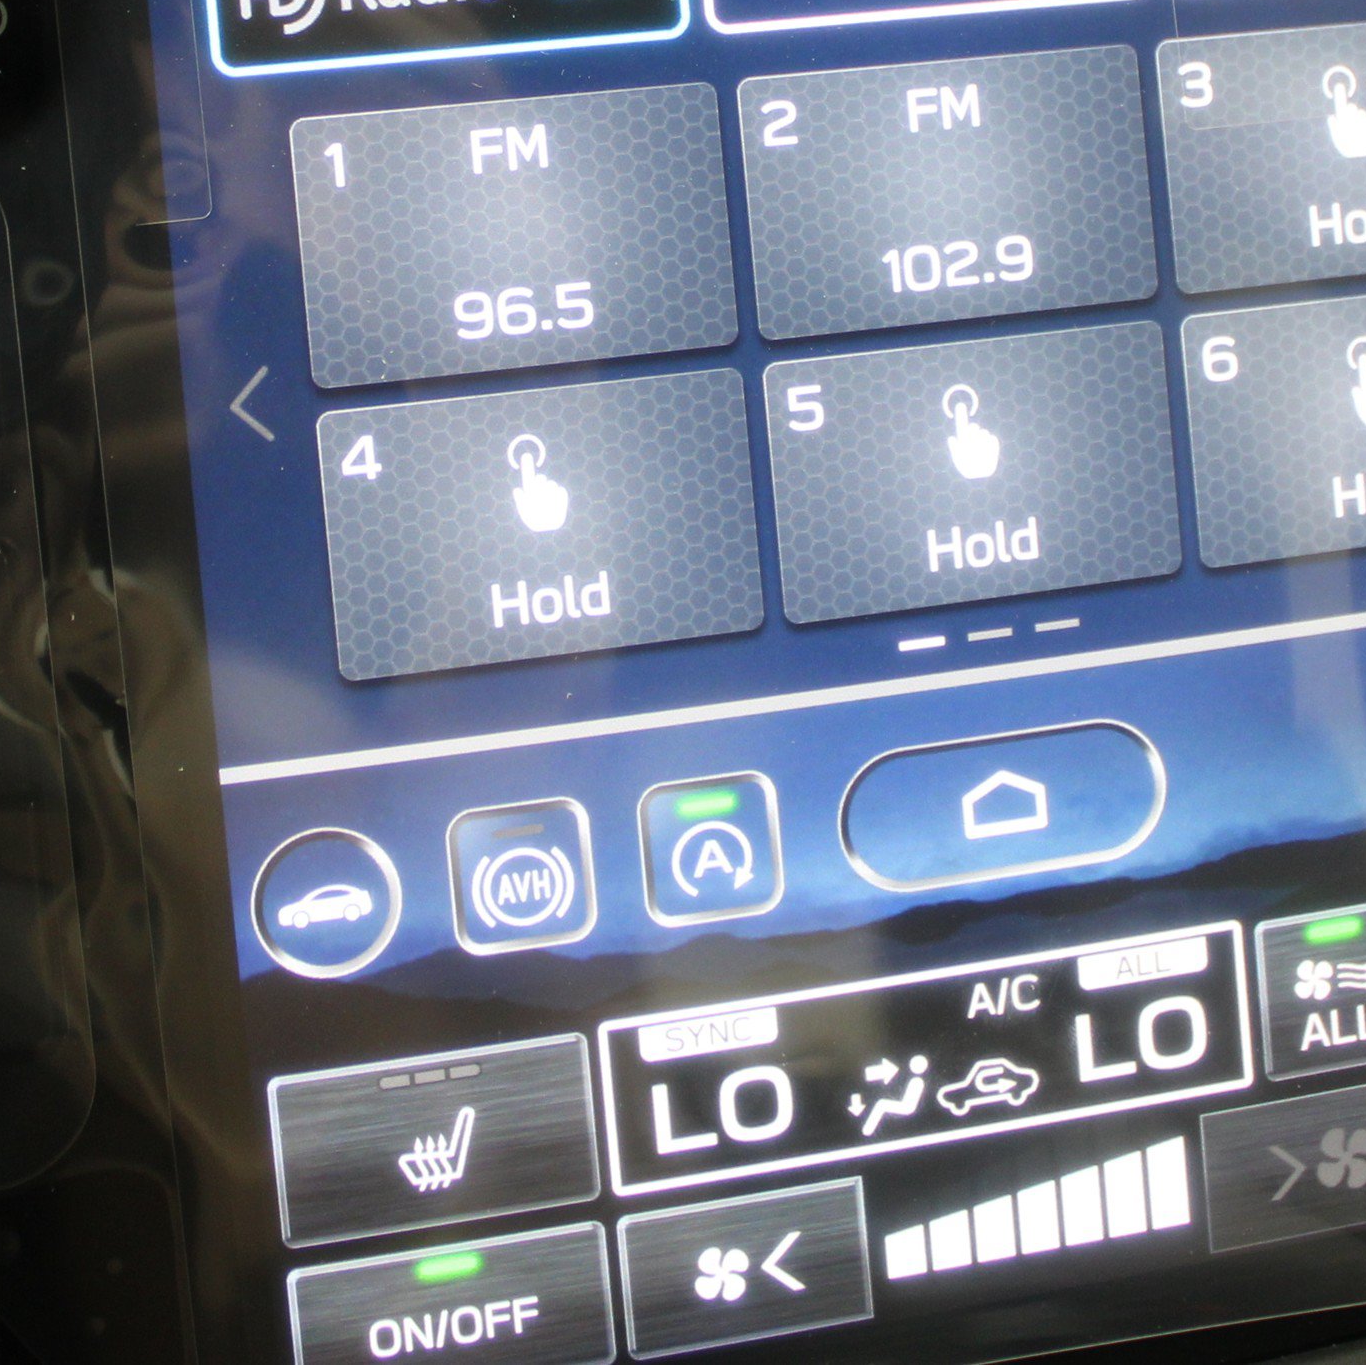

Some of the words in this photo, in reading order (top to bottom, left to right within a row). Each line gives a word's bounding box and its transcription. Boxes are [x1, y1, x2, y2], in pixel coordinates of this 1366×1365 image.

[1178, 61, 1215, 108] 3
[761, 100, 799, 147] 2
[907, 84, 981, 134] FM
[324, 142, 346, 188] 1
[470, 123, 550, 174] FM
[882, 234, 1034, 294] 102.9
[453, 281, 595, 340] 96.5
[1201, 336, 1239, 383] 6
[786, 384, 825, 432] 5
[340, 434, 383, 481] 4
[926, 516, 1040, 573] Hold
[491, 571, 612, 628] Hold
[497, 867, 552, 905] AVH
[1116, 949, 1172, 979] ALL
[967, 973, 1040, 1019] A/C
[665, 1016, 751, 1052] SYNC
[1076, 996, 1208, 1083] LO
[651, 1065, 793, 1155] LO
[368, 1295, 540, 1359] ON/OFF
